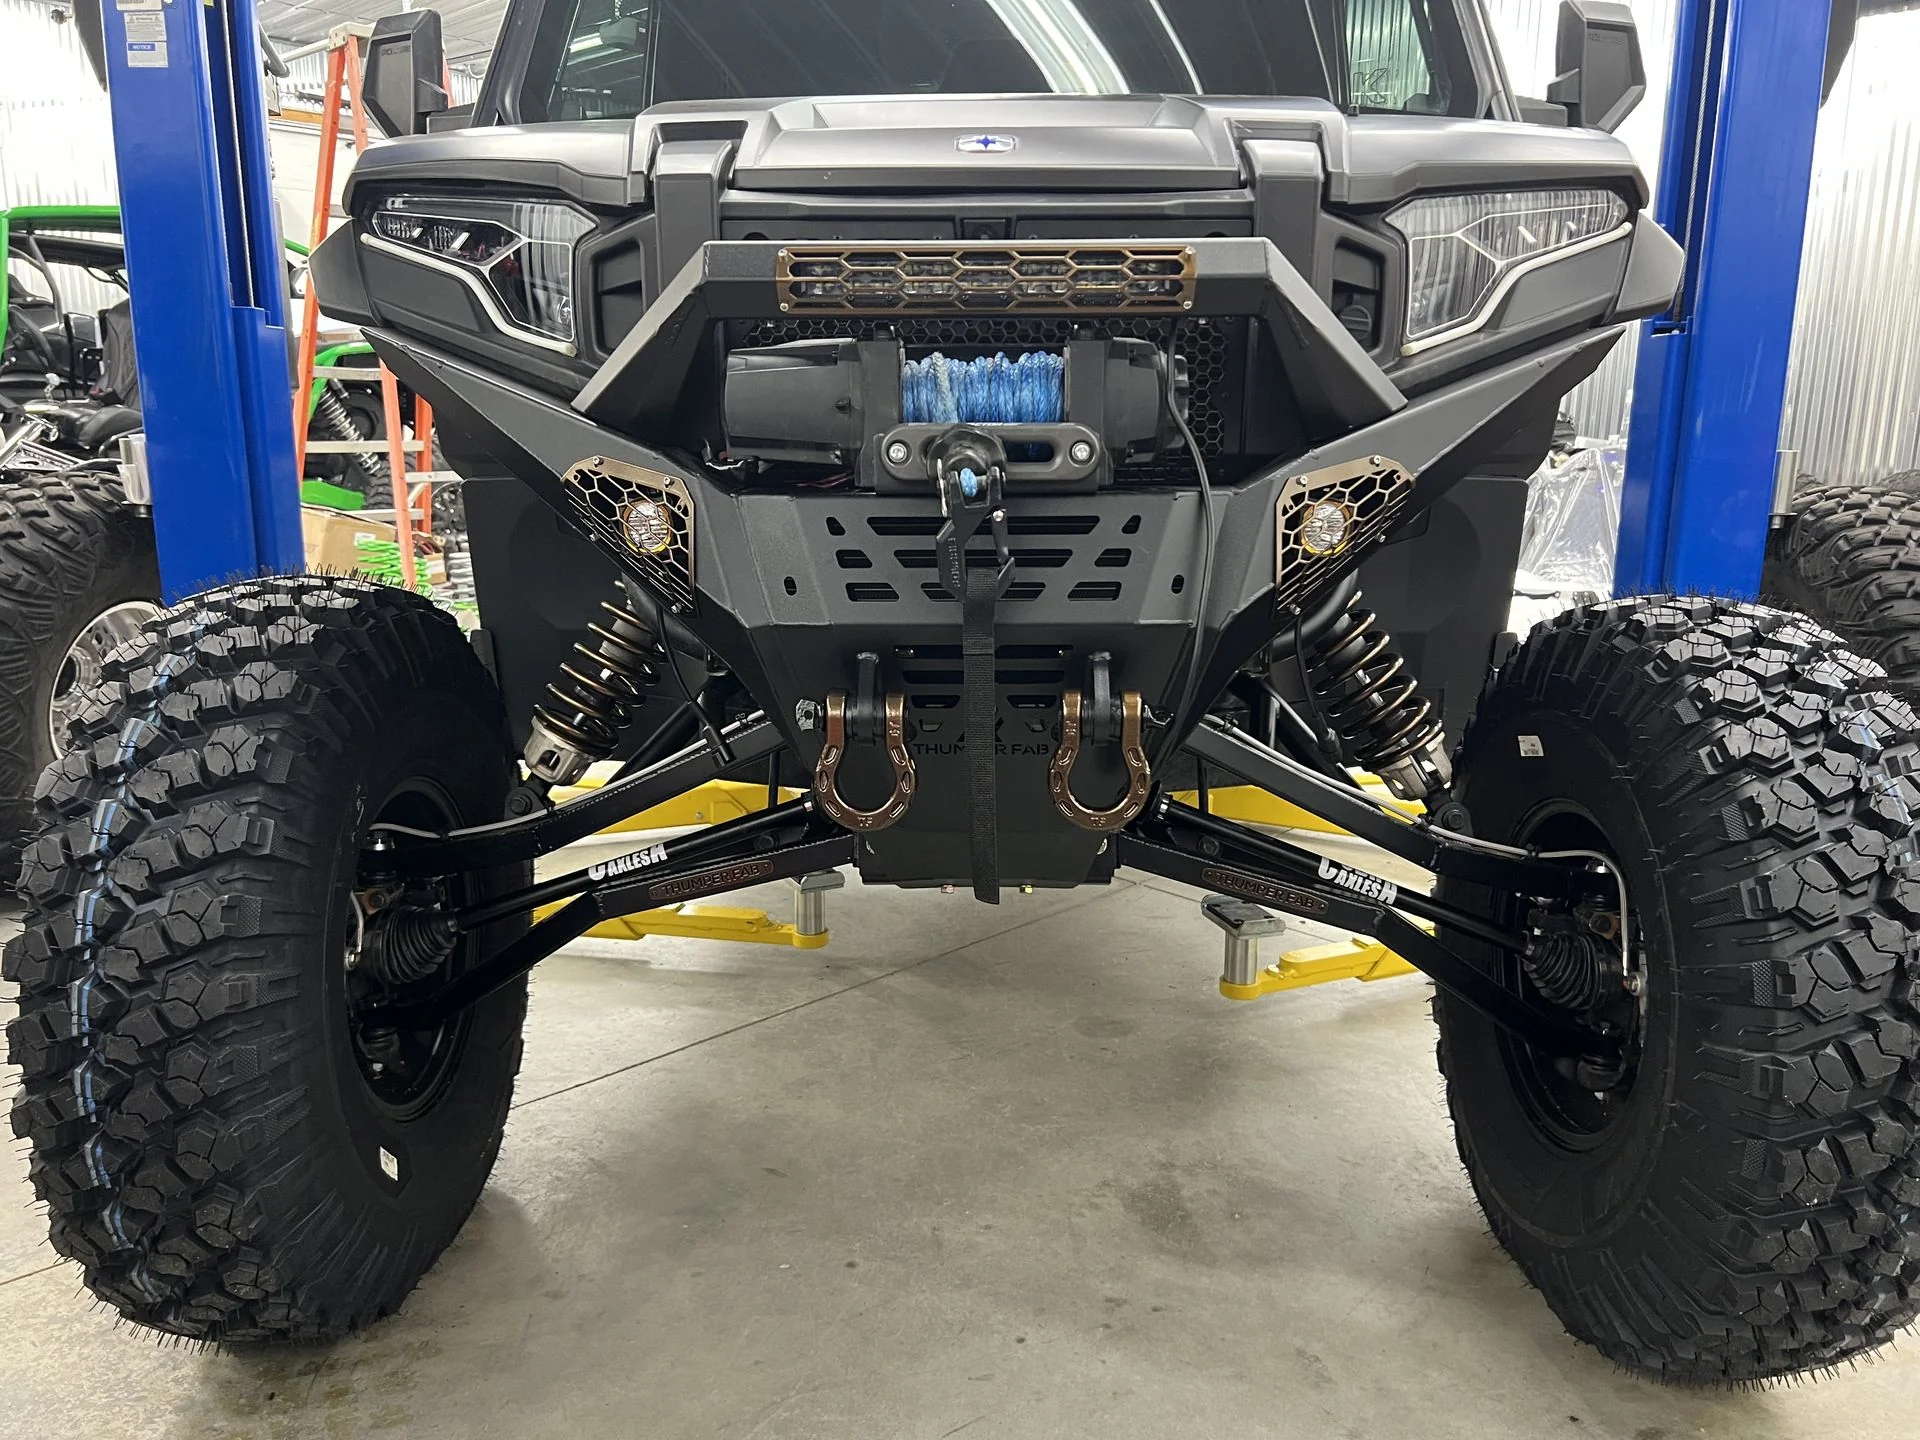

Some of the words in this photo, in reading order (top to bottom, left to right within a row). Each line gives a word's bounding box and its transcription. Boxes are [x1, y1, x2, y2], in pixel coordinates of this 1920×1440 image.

[913, 743, 1007, 755] THUMR
[1011, 743, 1049, 755] FAB
[661, 872, 730, 896] THUMPER
[732, 864, 761, 881] FAB
[1215, 872, 1284, 902] THUMPER
[1285, 892, 1314, 910] FAB
